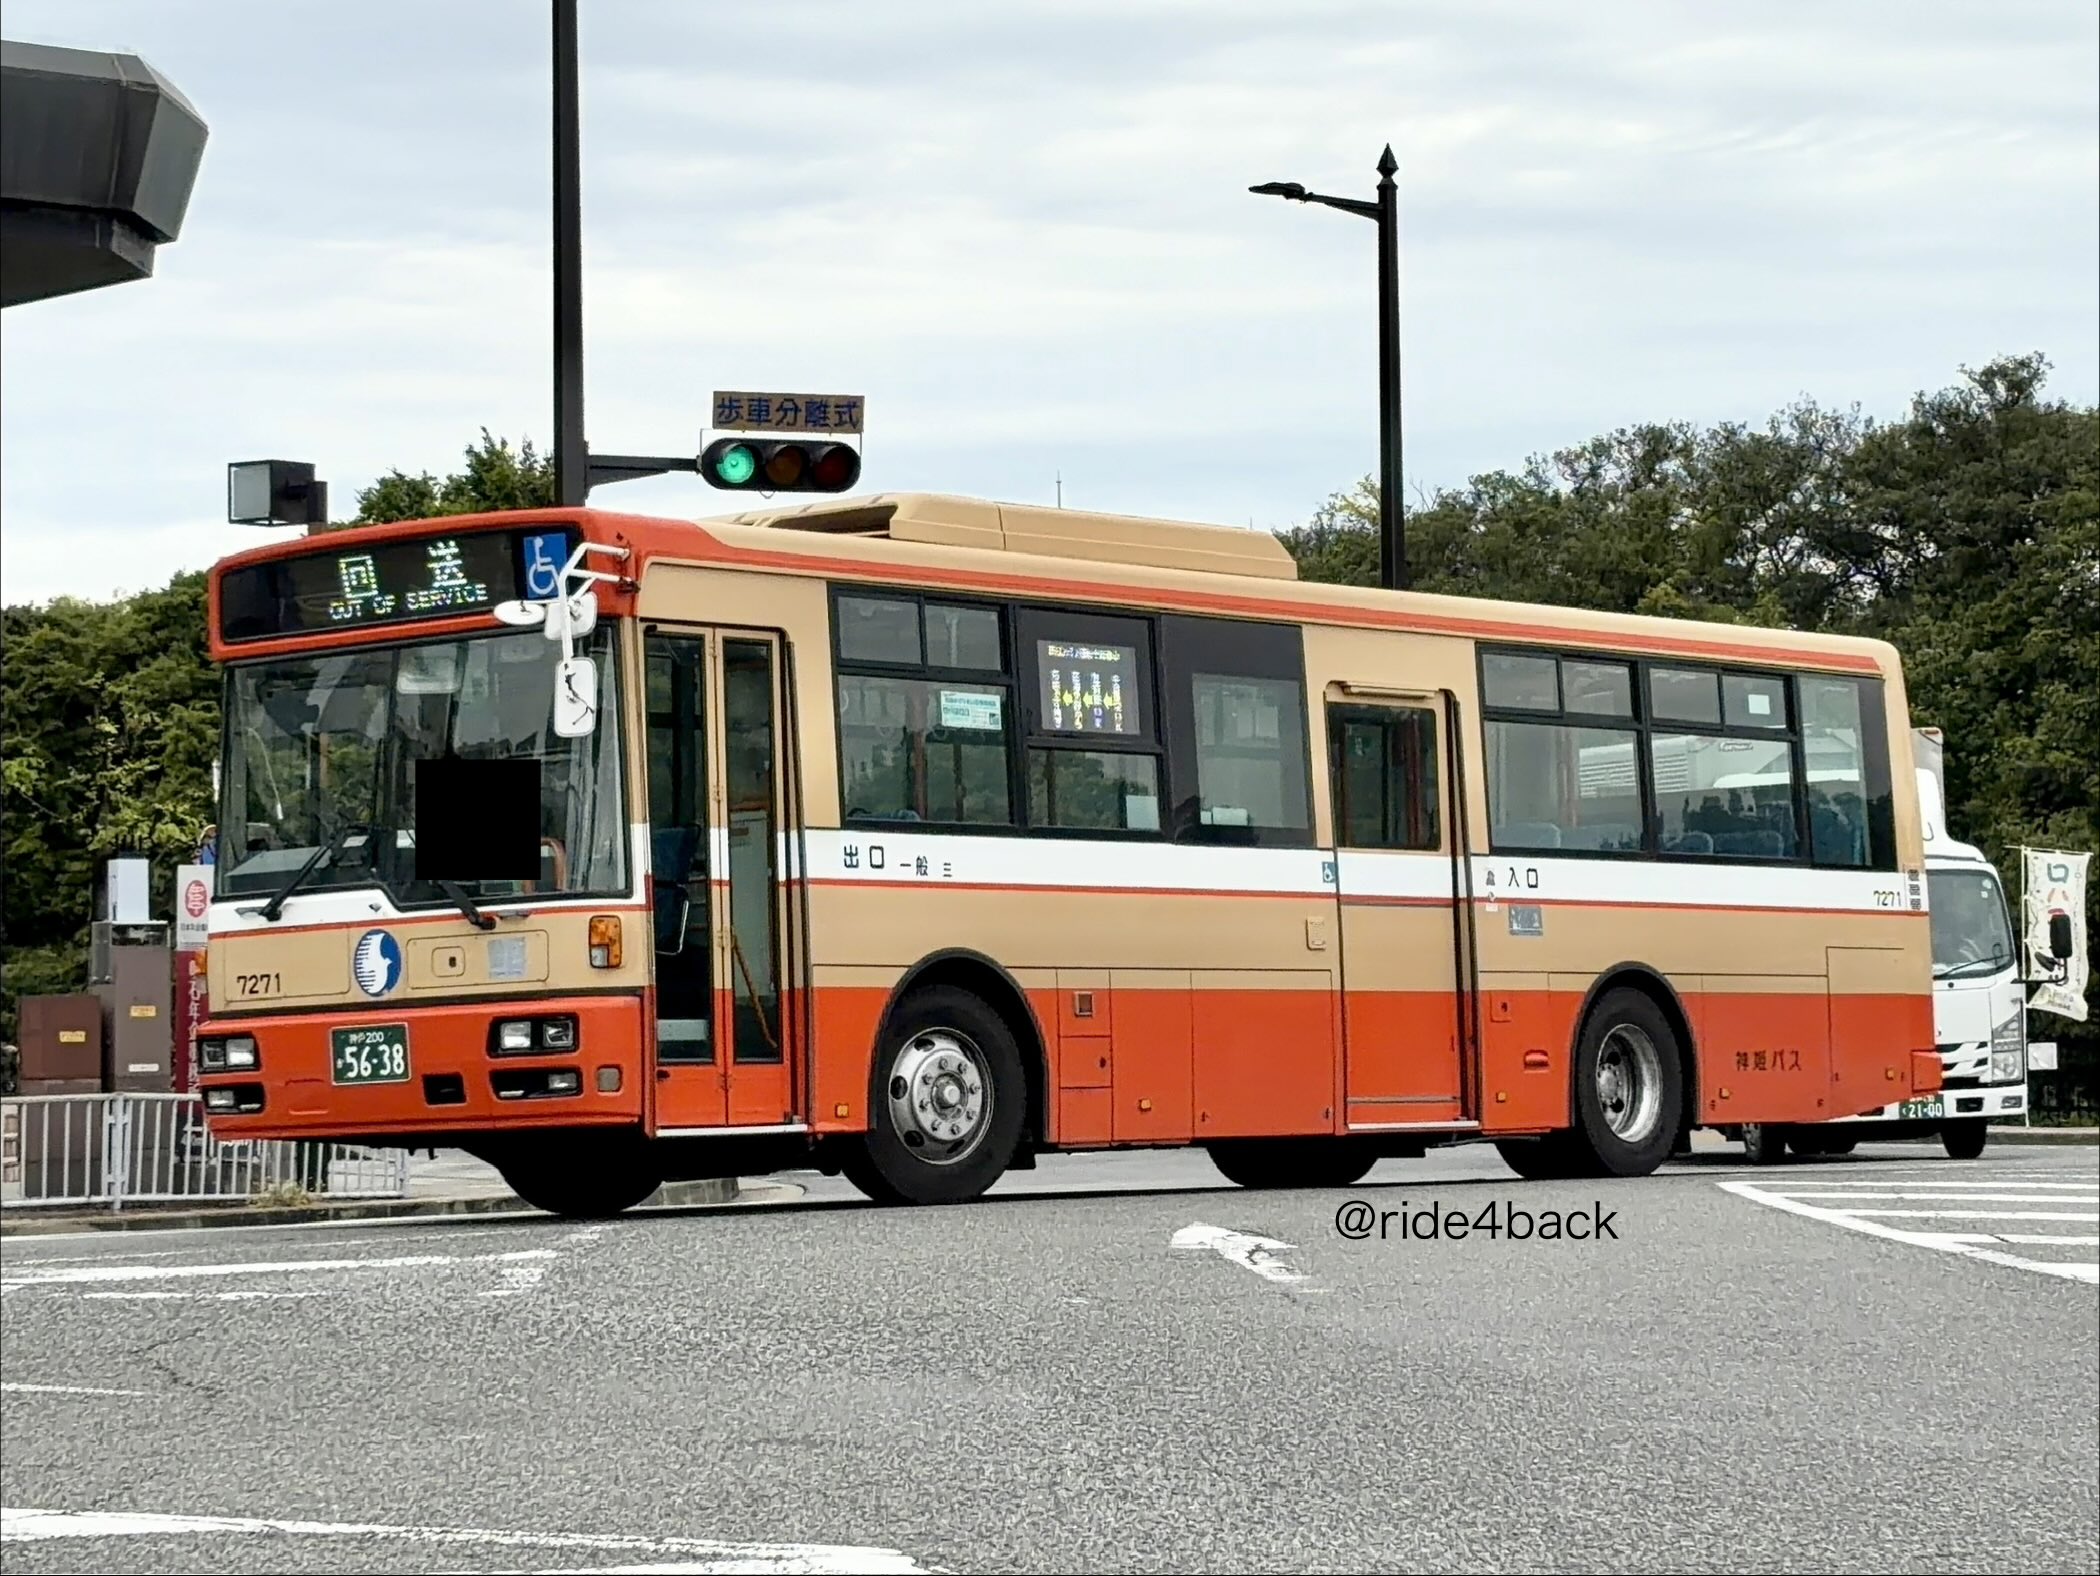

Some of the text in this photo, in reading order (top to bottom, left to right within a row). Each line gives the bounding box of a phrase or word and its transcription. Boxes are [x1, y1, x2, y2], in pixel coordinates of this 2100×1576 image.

[717, 397, 861, 429] 歩車分離式
[330, 583, 489, 620] OUT OF SERVICE
[843, 844, 885, 869] 出口
[1508, 866, 1539, 888] 入口
[1873, 890, 1901, 907] 7271
[236, 972, 281, 996] 7271
